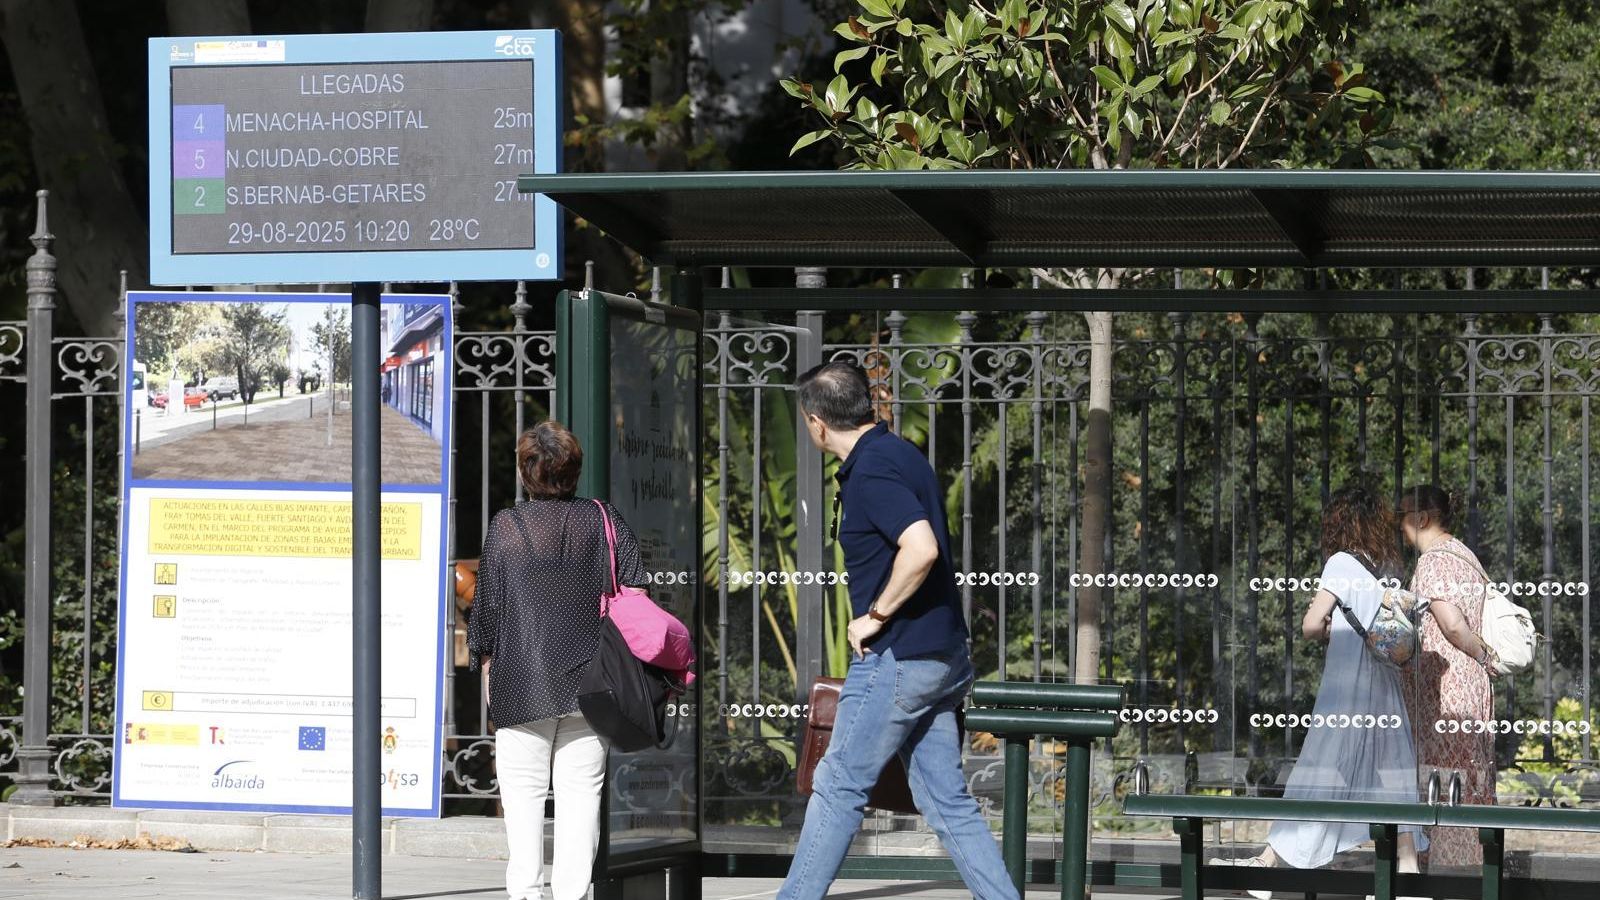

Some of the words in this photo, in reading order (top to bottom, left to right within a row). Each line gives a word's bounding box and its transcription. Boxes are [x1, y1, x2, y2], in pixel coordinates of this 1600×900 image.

[300, 74, 405, 95] LLEGADAS
[194, 113, 205, 134] 4
[226, 110, 429, 132] MENACHA-HOSPITAL
[494, 107, 533, 129] 25m
[194, 149, 205, 170] 5
[226, 146, 400, 169] N.CIUDAD-COBRE
[494, 144, 533, 165] 27m
[194, 186, 206, 207] 2
[226, 183, 426, 205] S.BERNAB-GETARES
[228, 221, 346, 244] 29-08-2025
[354, 220, 410, 242] 10:20
[163, 502, 217, 510] ACTUACIONES
[218, 502, 228, 510] EN
[230, 503, 244, 511] LAS
[246, 503, 274, 512] CALLES
[276, 504, 295, 512] BLAS
[333, 504, 352, 513] CAPI
[382, 504, 408, 514] AÑÓN,
[164, 512, 182, 520] FRAY
[212, 513, 227, 521] DEL
[256, 514, 286, 522] FUERTE
[287, 515, 327, 524] SANTIAGO
[391, 516, 407, 525] DEL
[198, 524, 210, 532] EN
[211, 524, 220, 532] EL
[222, 524, 250, 532] MARCO
[268, 526, 311, 534] PROGRAMA
[312, 526, 323, 534] DE
[382, 527, 407, 536] CIPIOS
[170, 533, 189, 541] PARA
[191, 534, 201, 542] LA
[260, 534, 272, 542] DE
[274, 535, 299, 544] ZONAS
[300, 536, 312, 544] DE
[313, 536, 337, 544] BAJAS
[389, 538, 399, 546] LA
[224, 544, 255, 552] DIGITAL
[257, 544, 263, 552] Y
[264, 545, 312, 554] SOSTENIBLE
[313, 546, 327, 554] DEL
[330, 546, 352, 555] TRAN
[211, 774, 265, 790] albaida
